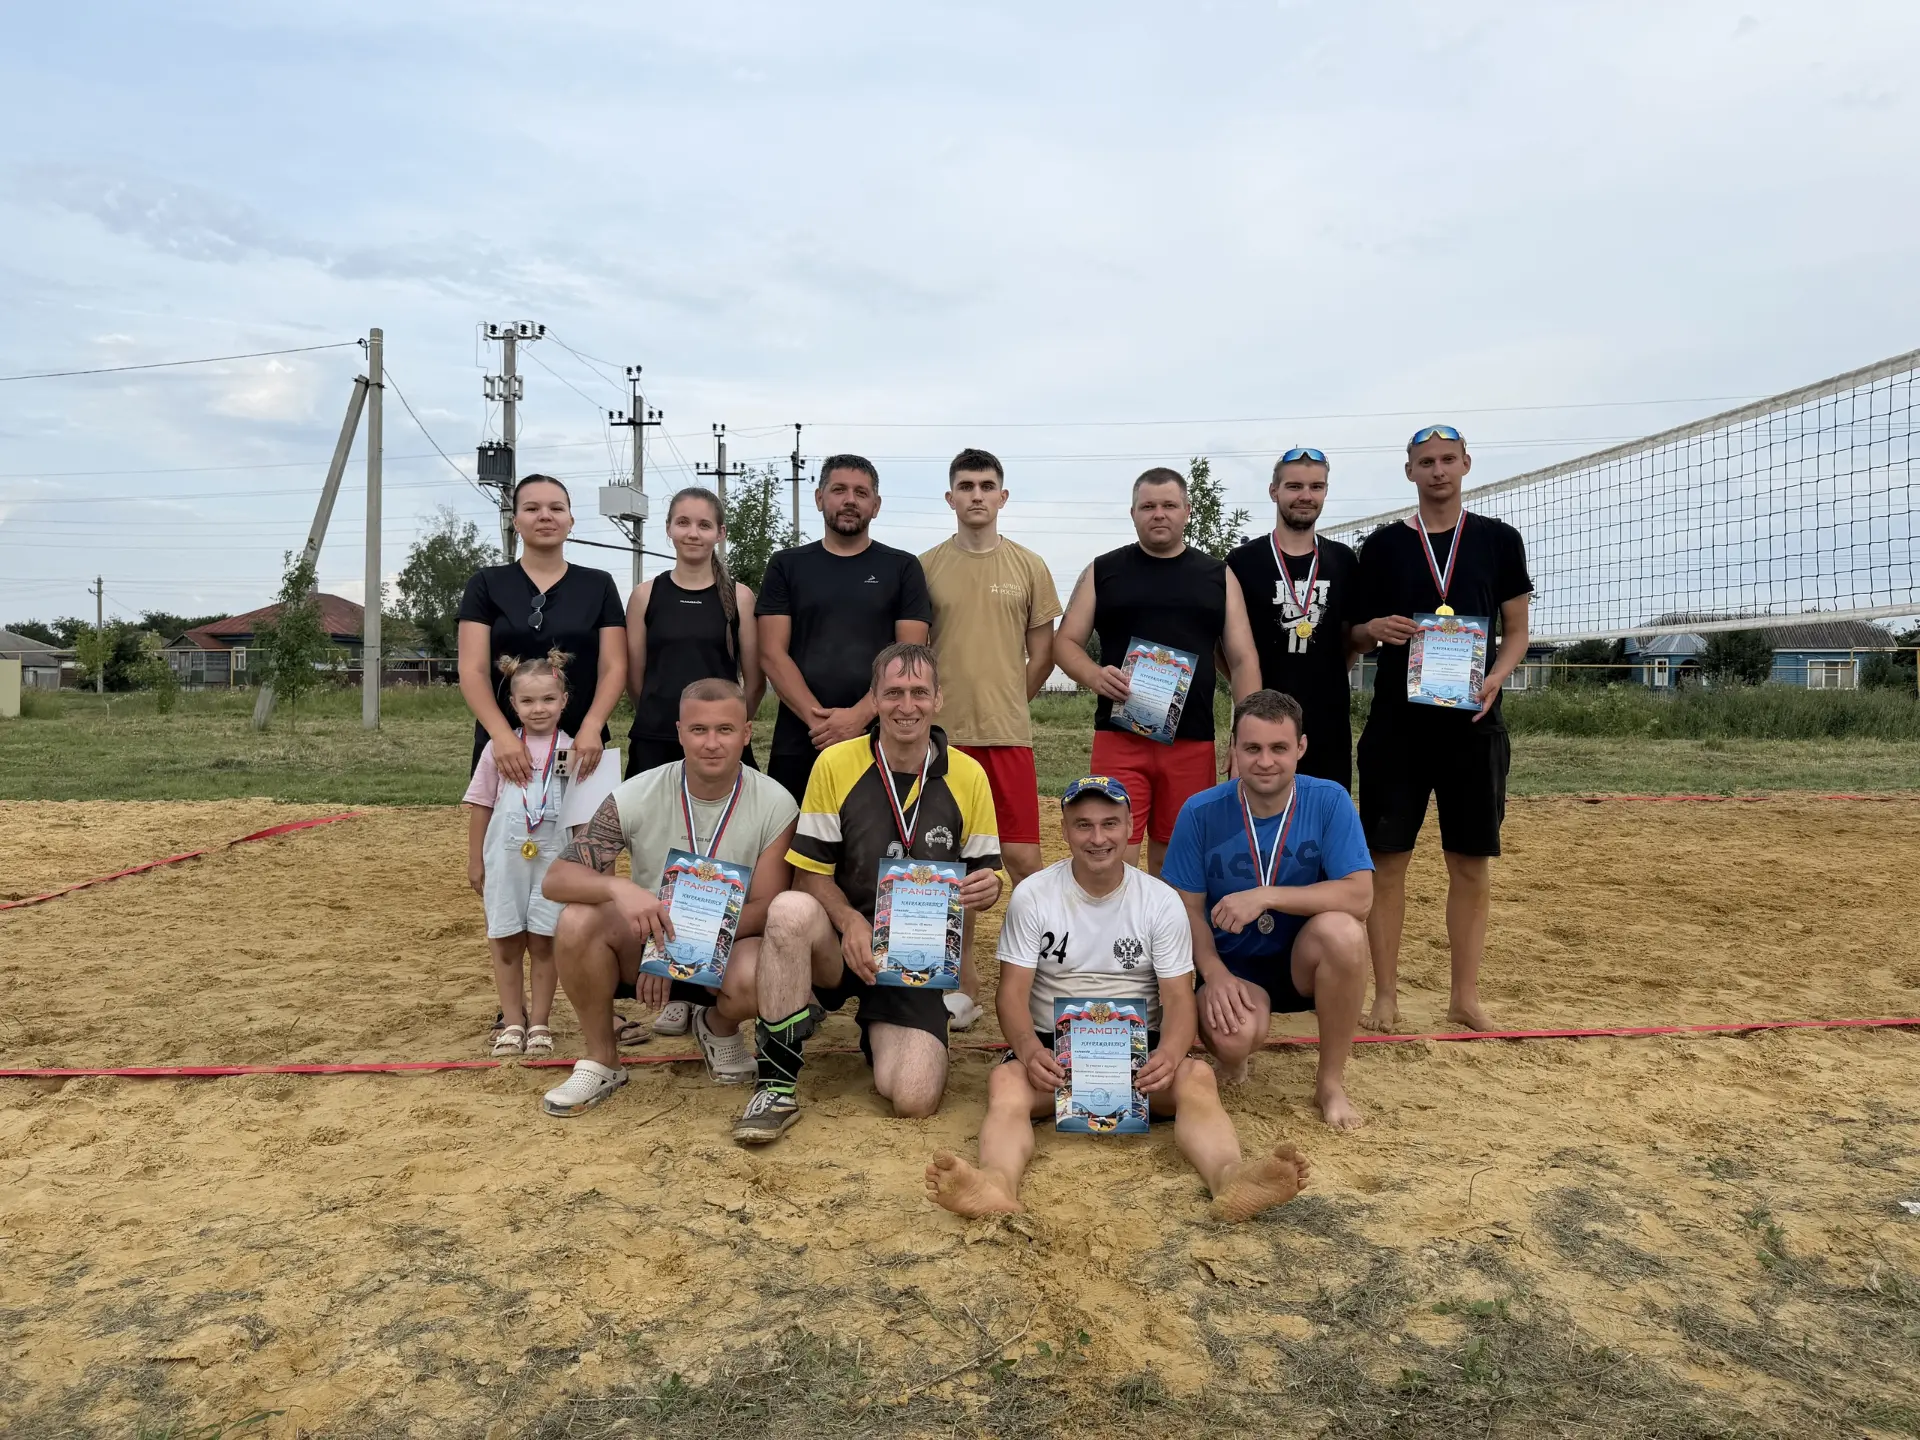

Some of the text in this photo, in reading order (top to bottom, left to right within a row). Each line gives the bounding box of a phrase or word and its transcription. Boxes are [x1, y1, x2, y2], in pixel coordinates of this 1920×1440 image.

[1426, 636, 1471, 644] ГРАМОТА
[1136, 661, 1178, 678] ГРАМОТА
[677, 880, 727, 897] ГРАМОТА
[895, 887, 947, 897] ГРАМОТА
[1040, 931, 1069, 964] 24
[1073, 1027, 1128, 1035] ГРАМОТА
